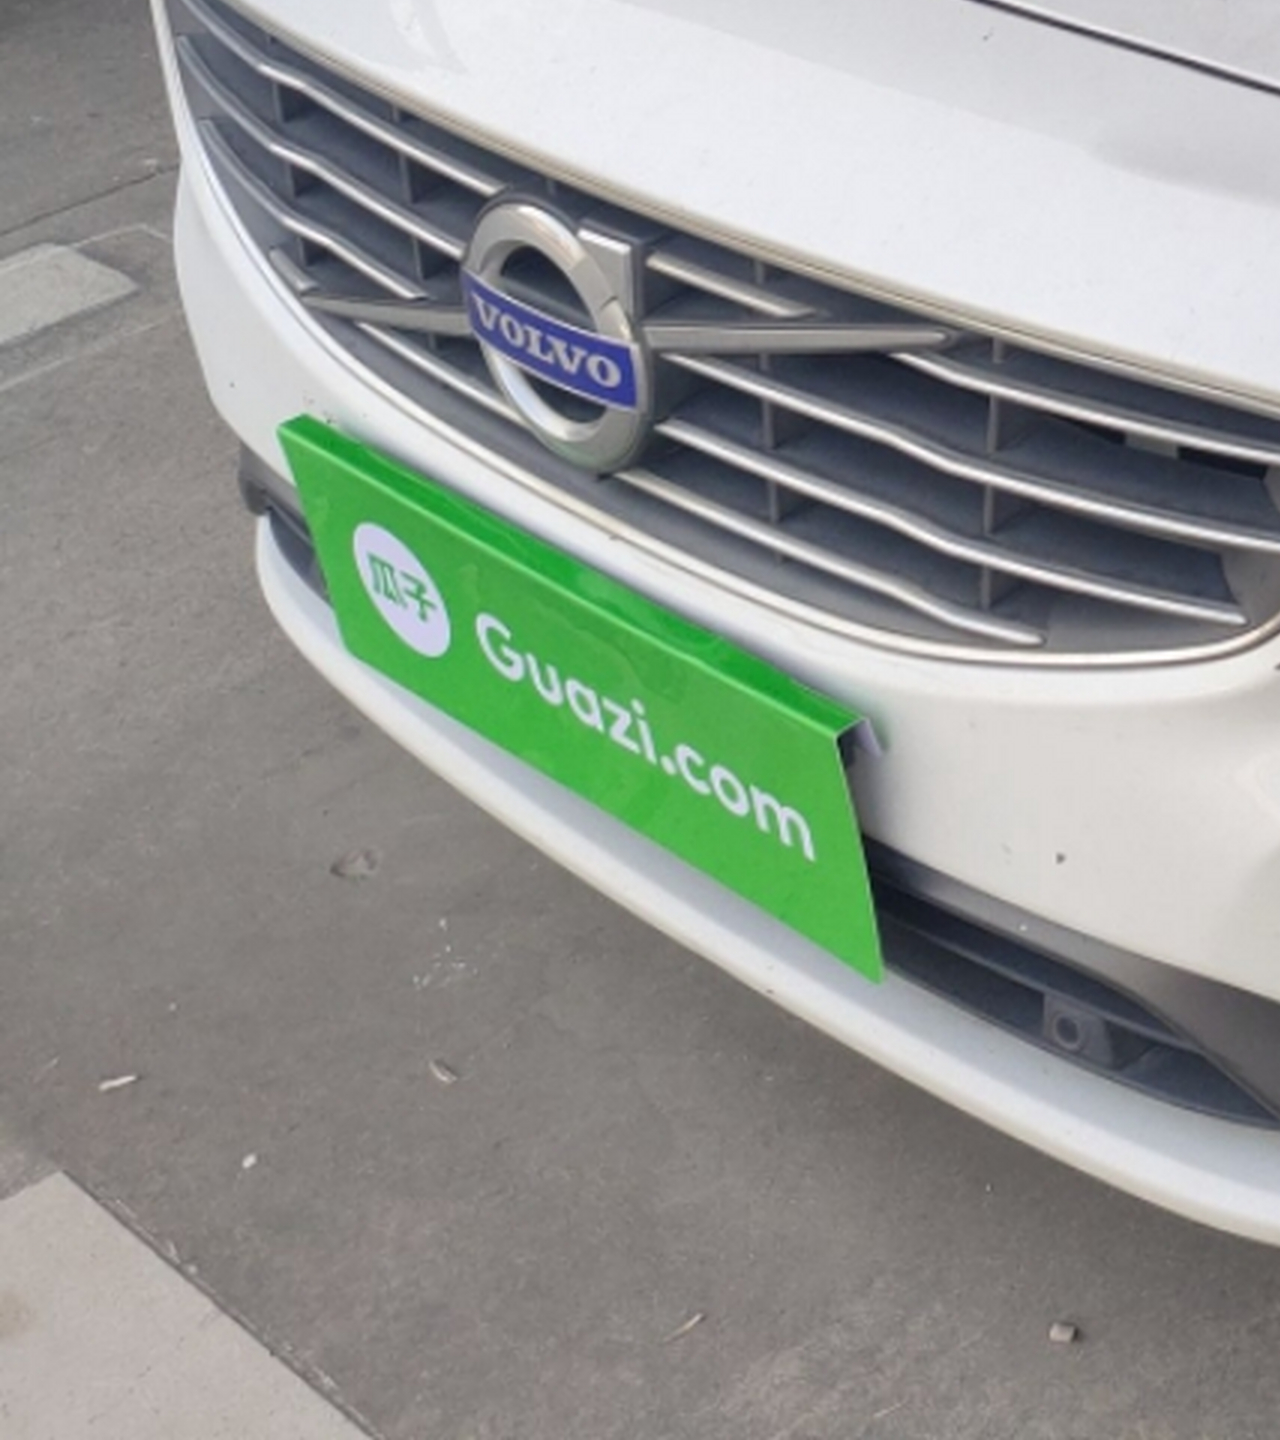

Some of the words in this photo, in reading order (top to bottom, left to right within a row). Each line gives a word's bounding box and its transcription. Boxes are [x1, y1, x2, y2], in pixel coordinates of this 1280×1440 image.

[473, 294, 622, 388] VOLVO
[367, 552, 436, 622] 瓜子
[475, 613, 815, 861] Guazi.com
